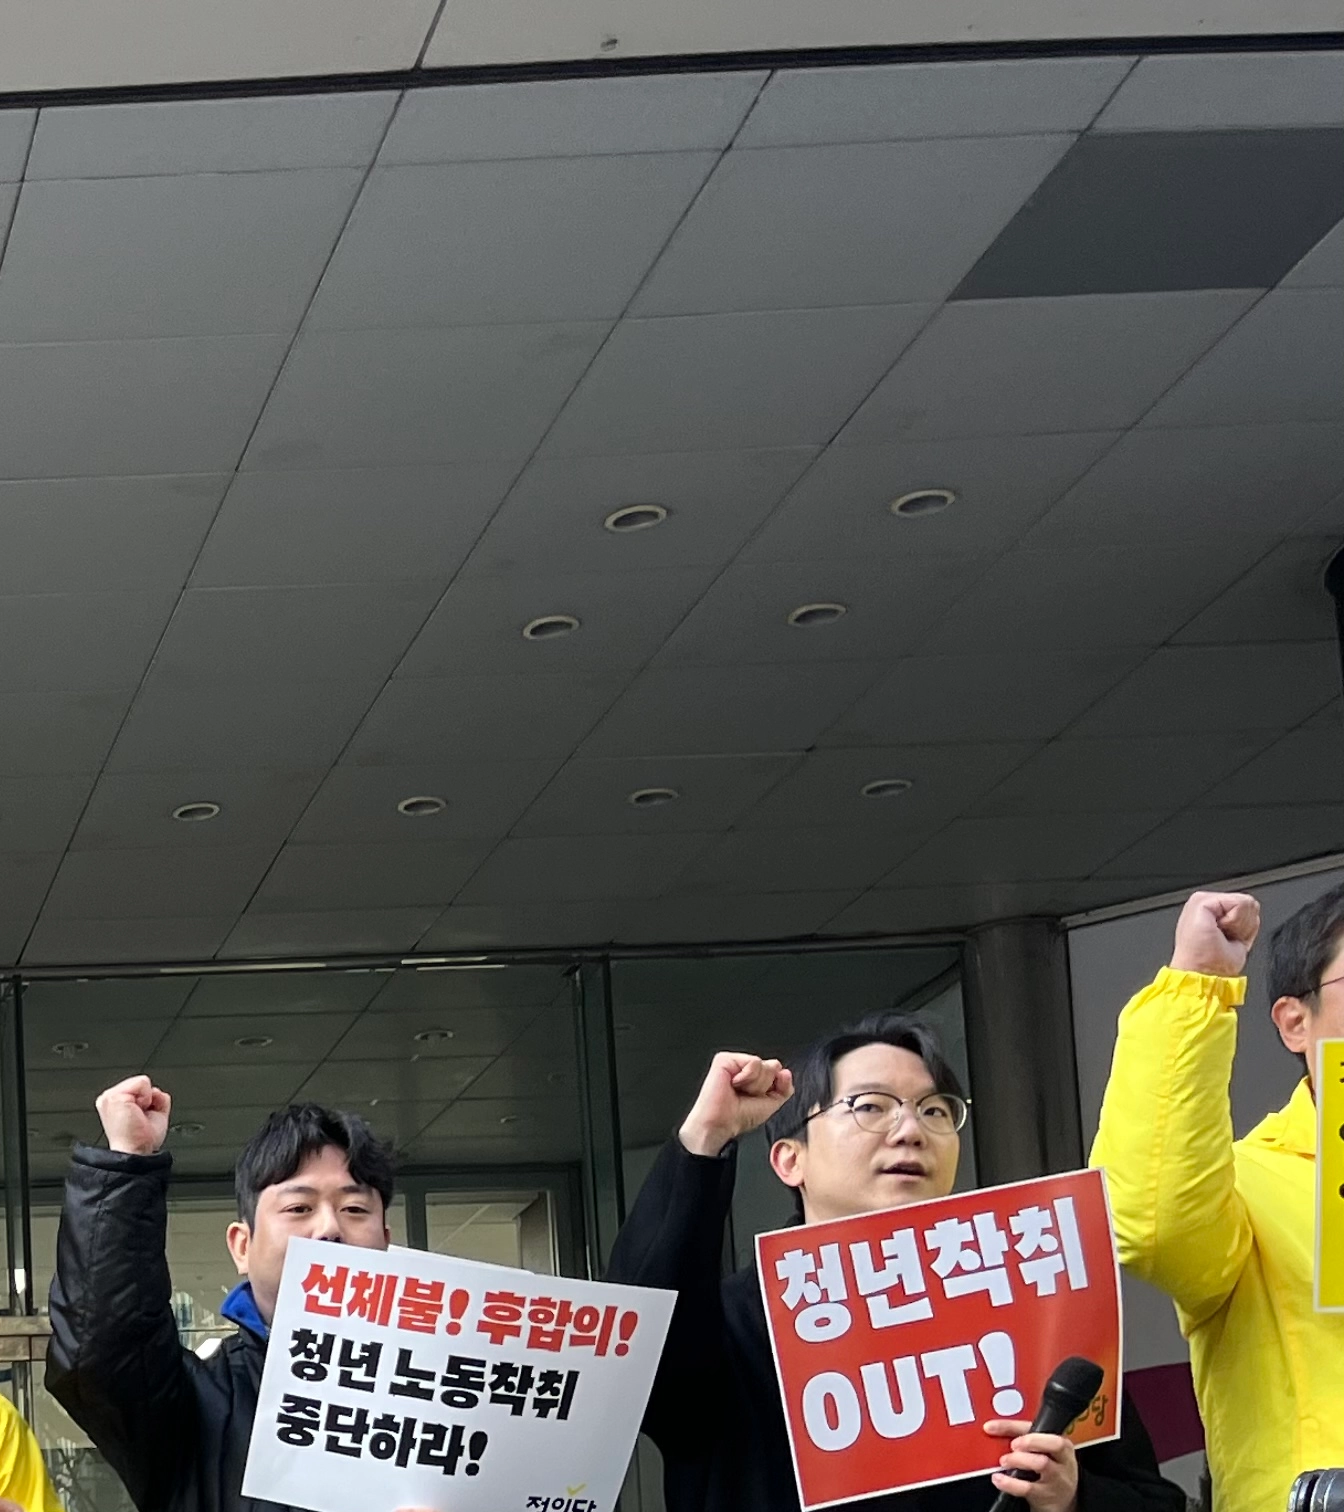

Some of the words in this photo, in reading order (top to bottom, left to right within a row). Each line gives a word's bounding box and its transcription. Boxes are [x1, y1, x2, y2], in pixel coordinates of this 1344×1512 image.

[300, 1262, 472, 1337] 선체불!
[475, 1289, 640, 1358] 후합의!
[775, 1195, 1089, 1344] 청년착취
[288, 1326, 381, 1393] 청년
[388, 1346, 580, 1422] 노동착취
[801, 1330, 1024, 1453] OUT!
[274, 1392, 490, 1478] 중단하라!
